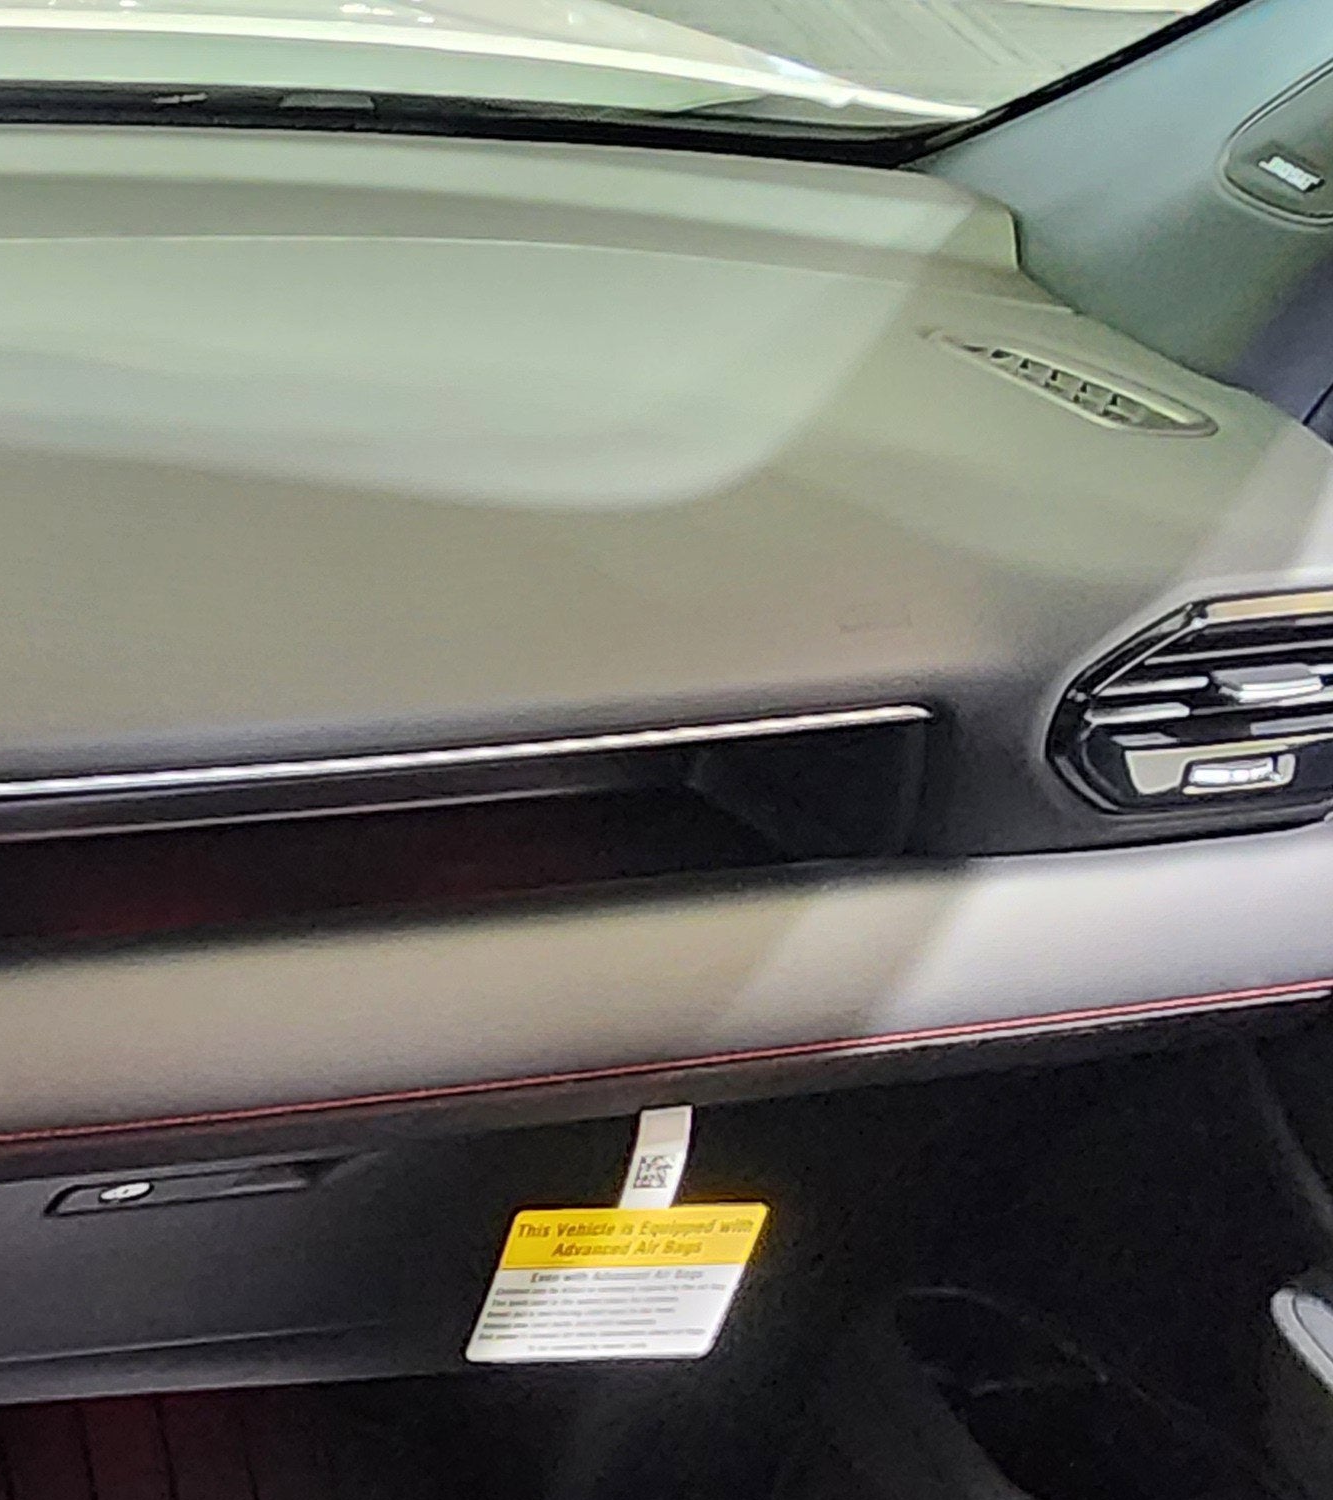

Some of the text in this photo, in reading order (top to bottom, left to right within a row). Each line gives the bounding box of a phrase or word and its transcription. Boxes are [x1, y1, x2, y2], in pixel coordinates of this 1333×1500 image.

[517, 1219, 755, 1238] This Vehicle is Equipped with
[551, 1240, 703, 1257] Advanced Air Bags
